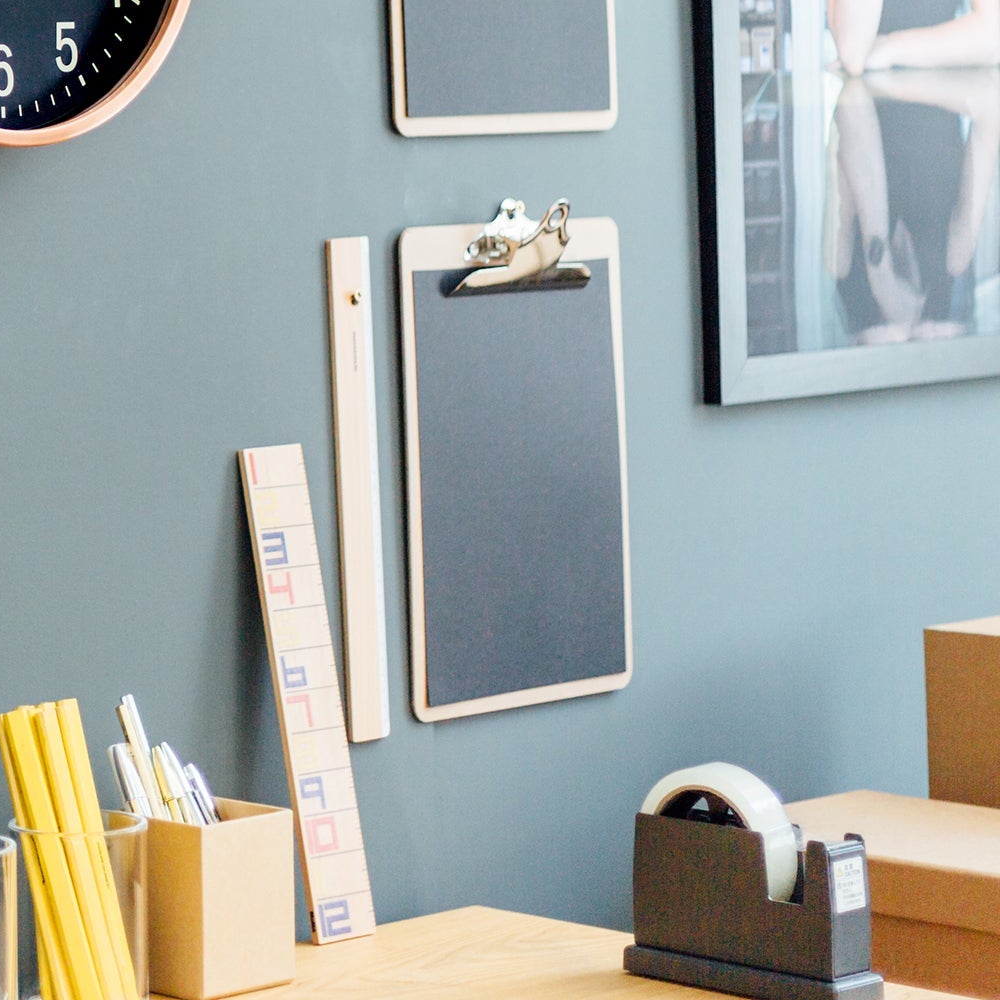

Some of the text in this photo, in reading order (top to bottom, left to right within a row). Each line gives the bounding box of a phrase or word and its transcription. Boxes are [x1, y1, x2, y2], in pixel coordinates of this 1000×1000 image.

[56, 22, 78, 72] 5
[267, 572, 294, 605] 4
[280, 655, 307, 689] 6
[286, 694, 313, 727] 7
[299, 776, 326, 809] 9
[318, 900, 352, 937] 12
